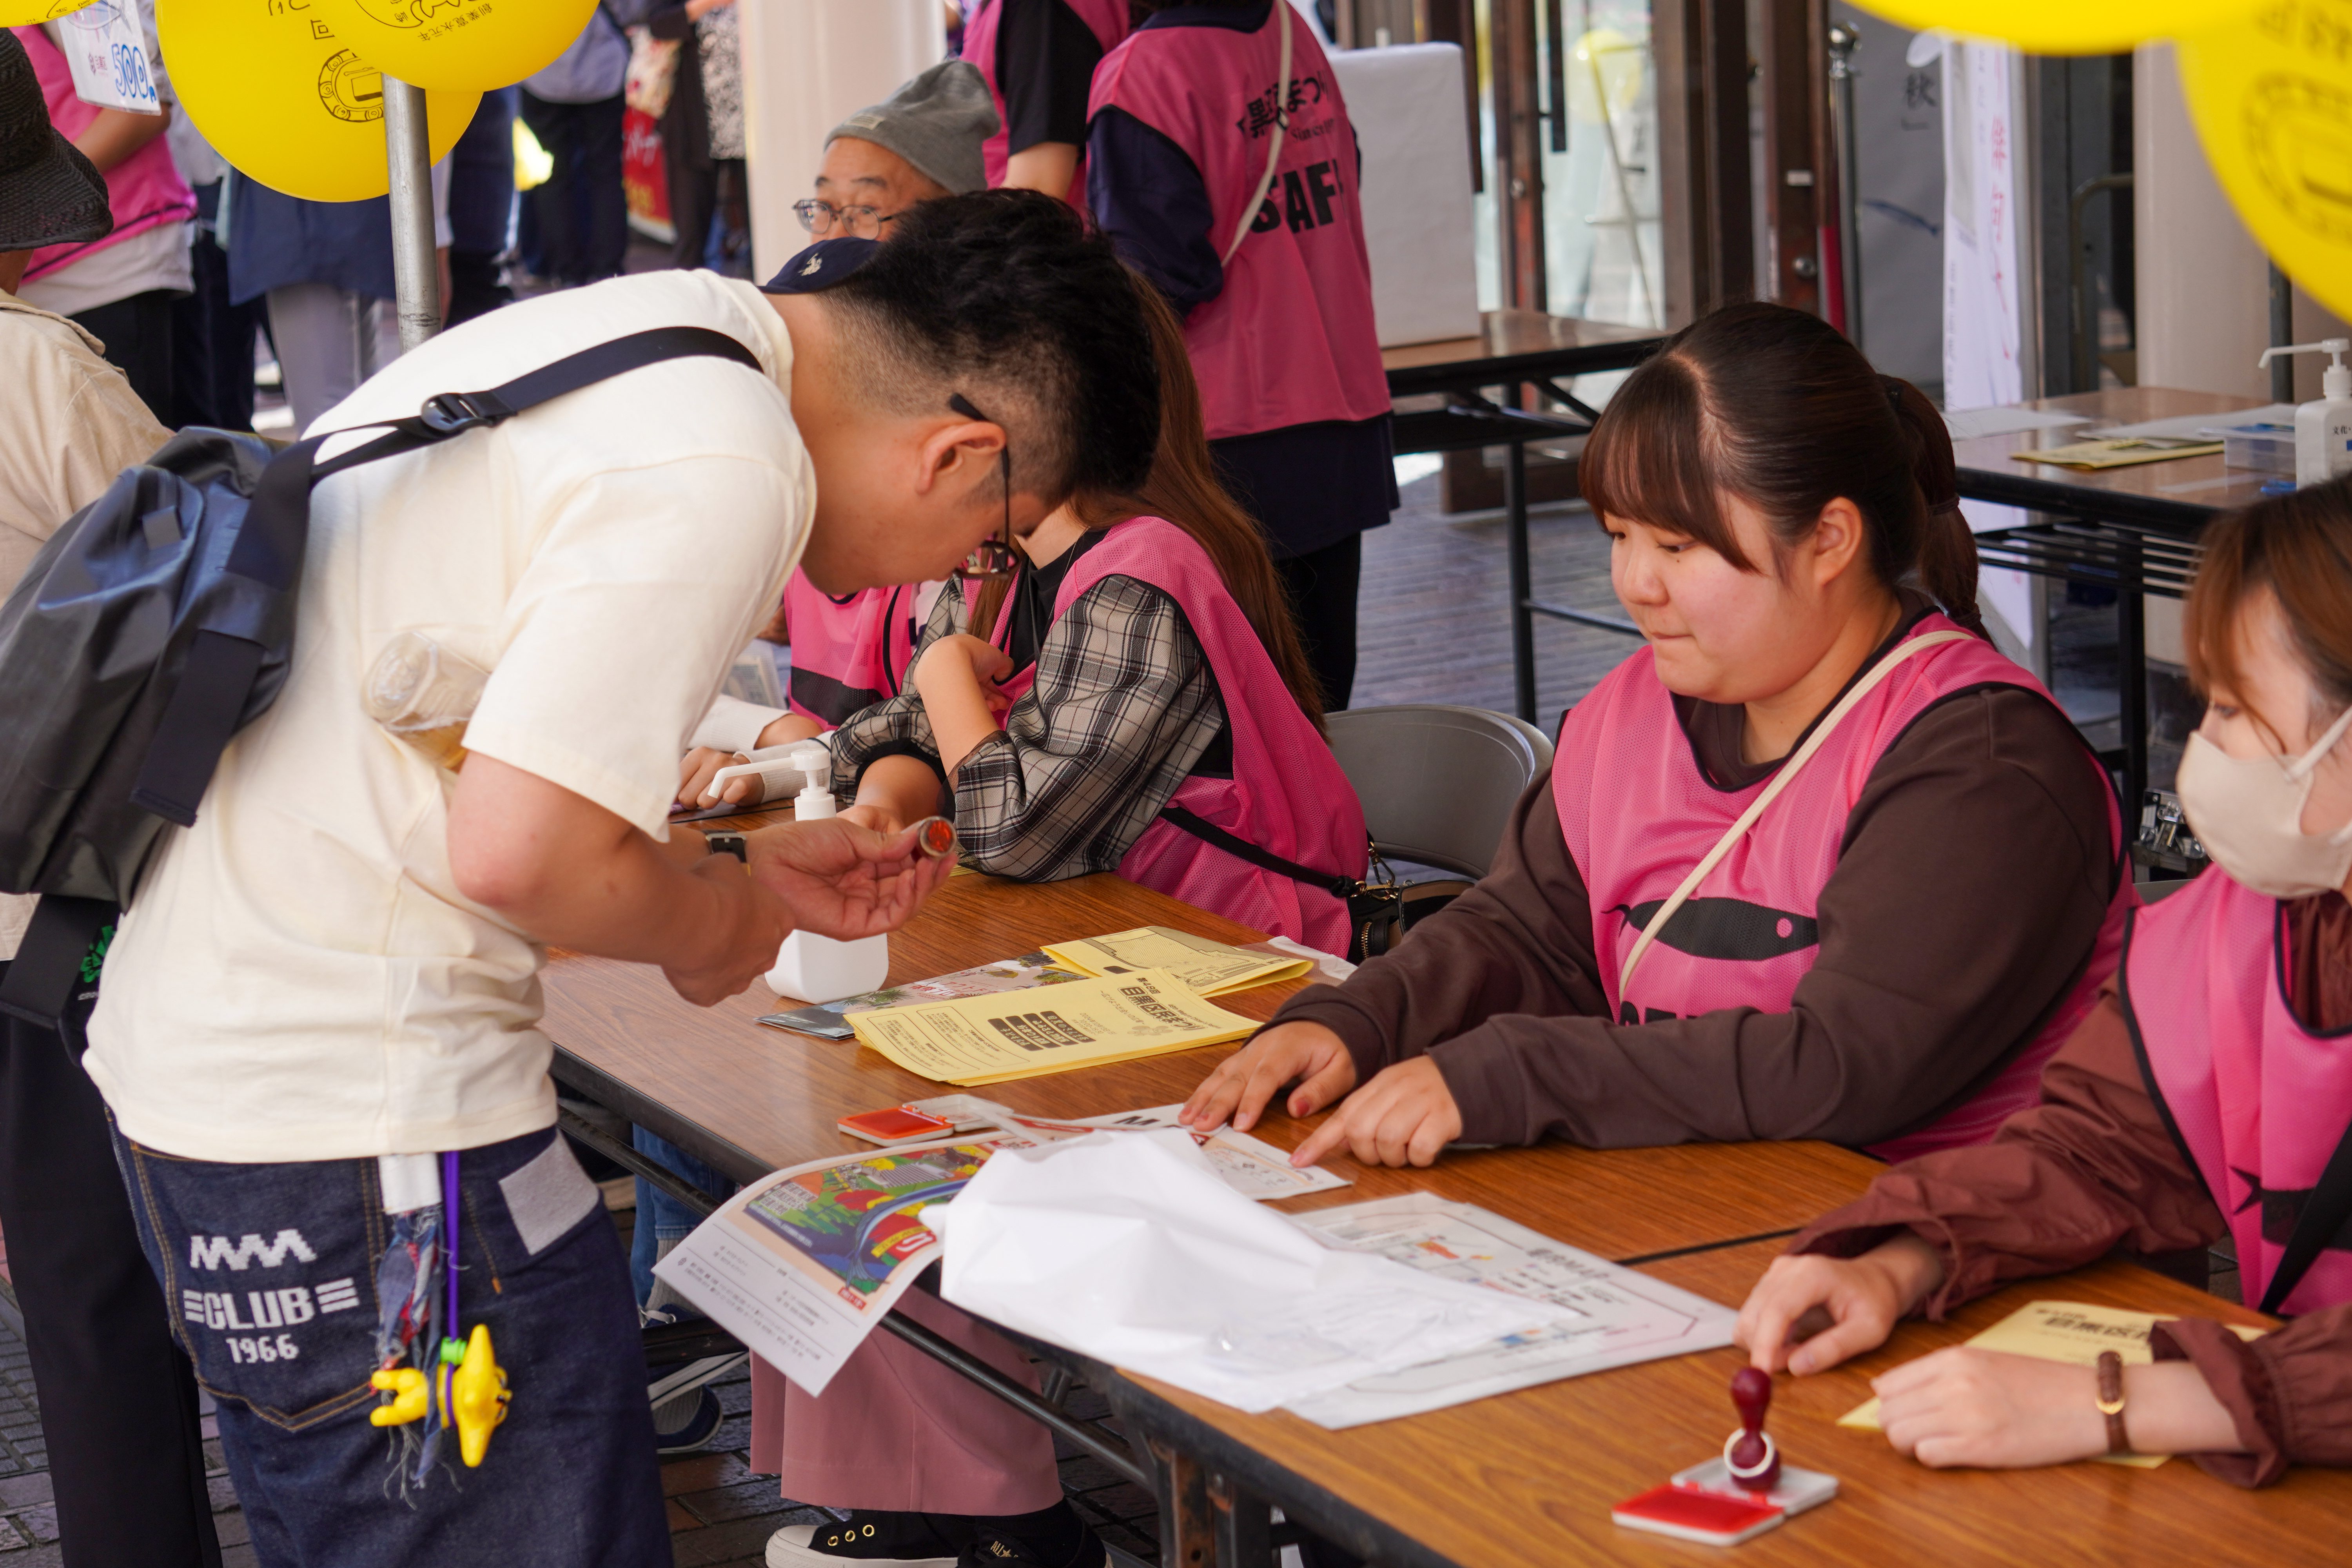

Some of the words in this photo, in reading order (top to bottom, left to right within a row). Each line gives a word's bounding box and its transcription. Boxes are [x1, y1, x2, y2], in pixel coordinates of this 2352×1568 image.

[1136, 977, 1161, 994] 第48回
[1118, 986, 1207, 1031] 目黒区民まつり
[1000, 1028, 1031, 1046] 子ども広場
[1047, 1015, 1090, 1041] 目黒のさんま祭
[203, 1287, 315, 1330] CLUB
[225, 1334, 299, 1363] 1966
